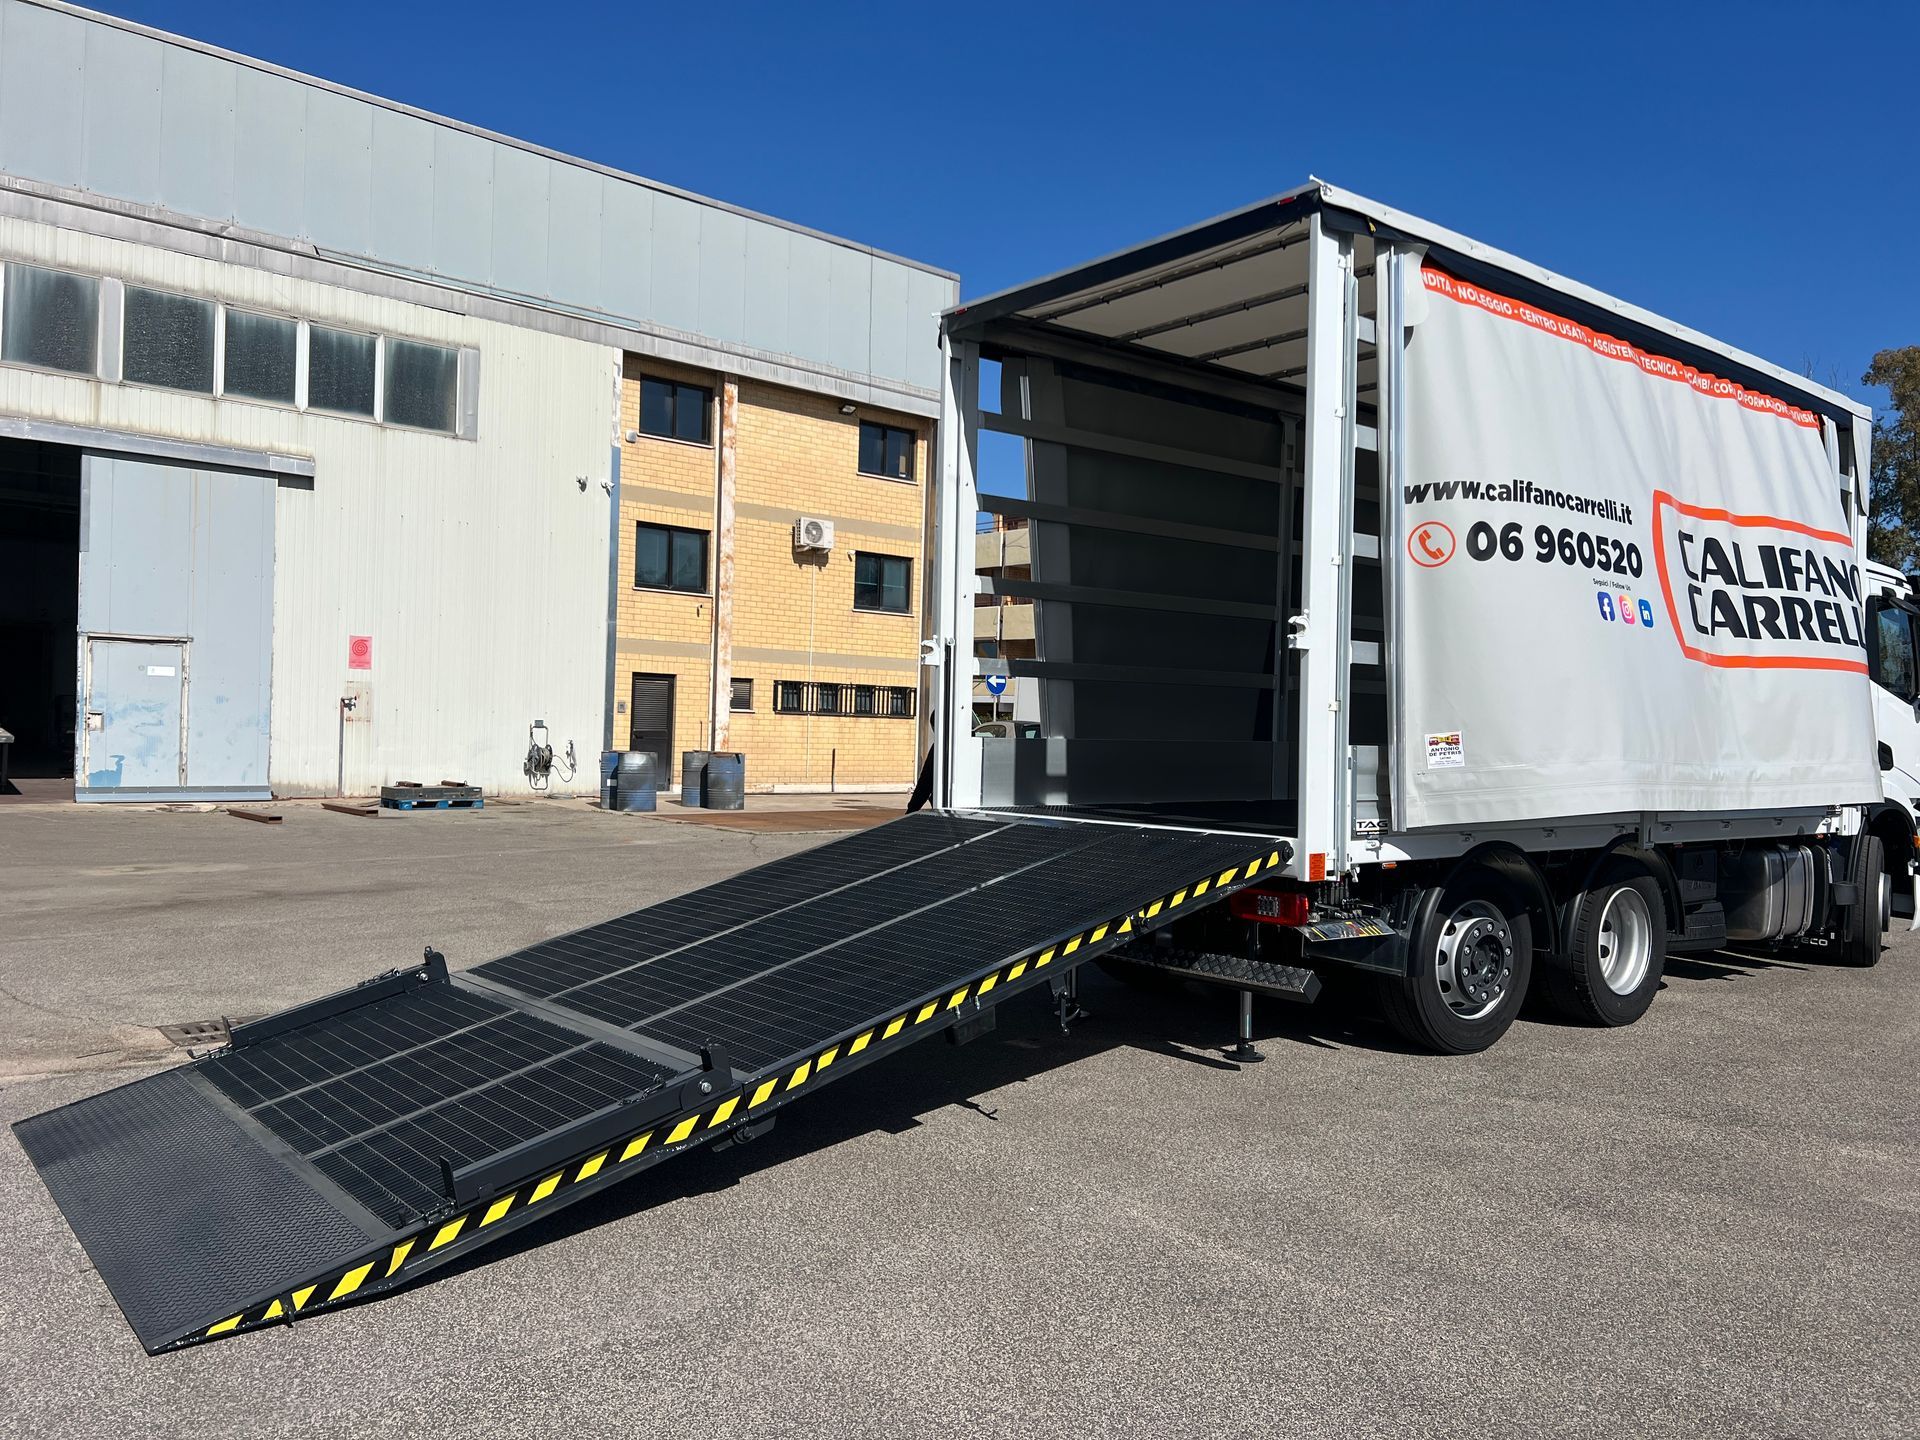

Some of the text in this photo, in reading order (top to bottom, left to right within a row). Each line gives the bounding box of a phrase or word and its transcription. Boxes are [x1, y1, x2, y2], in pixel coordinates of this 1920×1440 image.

[1457, 286, 1512, 315] NOLEGGIO
[1519, 307, 1557, 331] CENTRO
[1640, 356, 1678, 376] TECNICA
[1404, 479, 1633, 525] www.califanocarrelli.it
[1466, 520, 1643, 578] 06 960520
[1678, 529, 1863, 607] CALIFANO
[1592, 577, 1609, 587] Seguici
[1612, 581, 1625, 590] Follow
[1356, 820, 1388, 828] TAG
